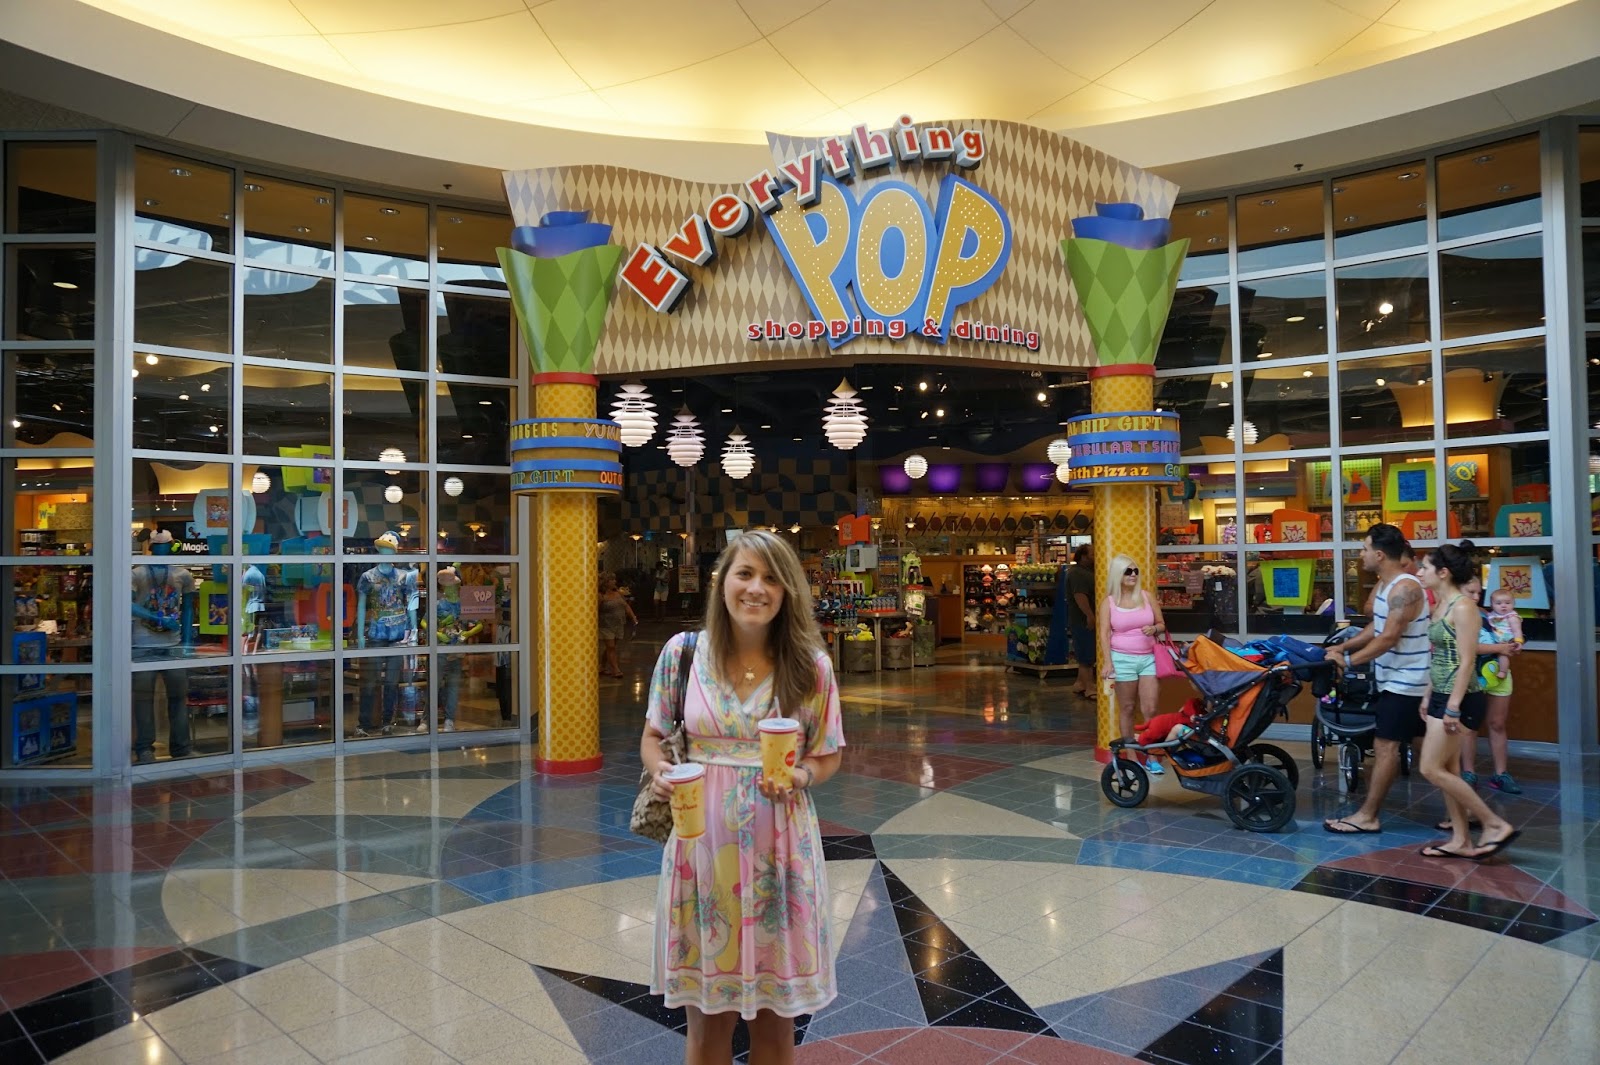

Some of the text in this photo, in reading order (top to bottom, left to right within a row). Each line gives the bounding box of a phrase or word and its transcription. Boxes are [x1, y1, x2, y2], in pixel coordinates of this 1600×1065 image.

[619, 114, 986, 314] Everything
[767, 174, 1010, 347] POP
[747, 315, 1040, 350] shopping & dining
[511, 422, 558, 440] URGERS
[1081, 417, 1110, 434] HIP
[1117, 415, 1163, 431] GIFT
[530, 469, 575, 484] GIFT
[473, 590, 492, 602] POP
